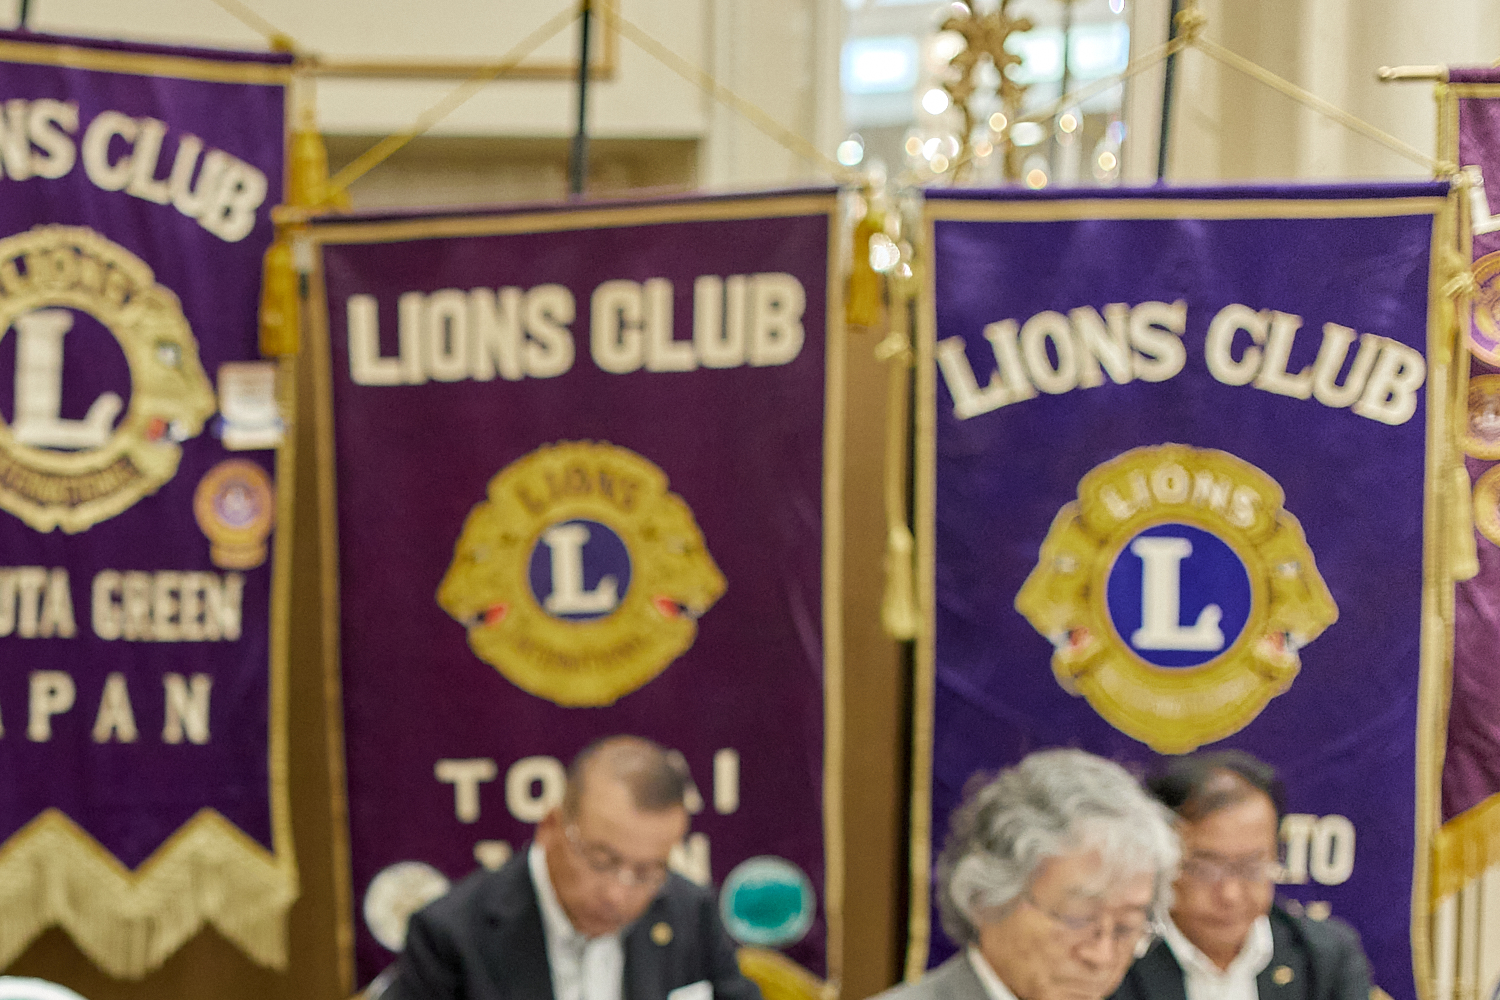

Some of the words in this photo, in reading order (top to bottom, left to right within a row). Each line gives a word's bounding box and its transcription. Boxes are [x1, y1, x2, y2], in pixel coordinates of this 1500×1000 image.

[82, 109, 268, 243] CLUB
[12, 309, 124, 447] L
[346, 283, 577, 386] LIONS
[589, 272, 808, 374] CLUB
[937, 299, 1188, 421] LIONS
[1204, 303, 1427, 426] CLUB
[1100, 462, 1261, 528] LIONS
[90, 568, 245, 642] GREEN
[540, 522, 619, 616] L
[1130, 535, 1226, 651] L
